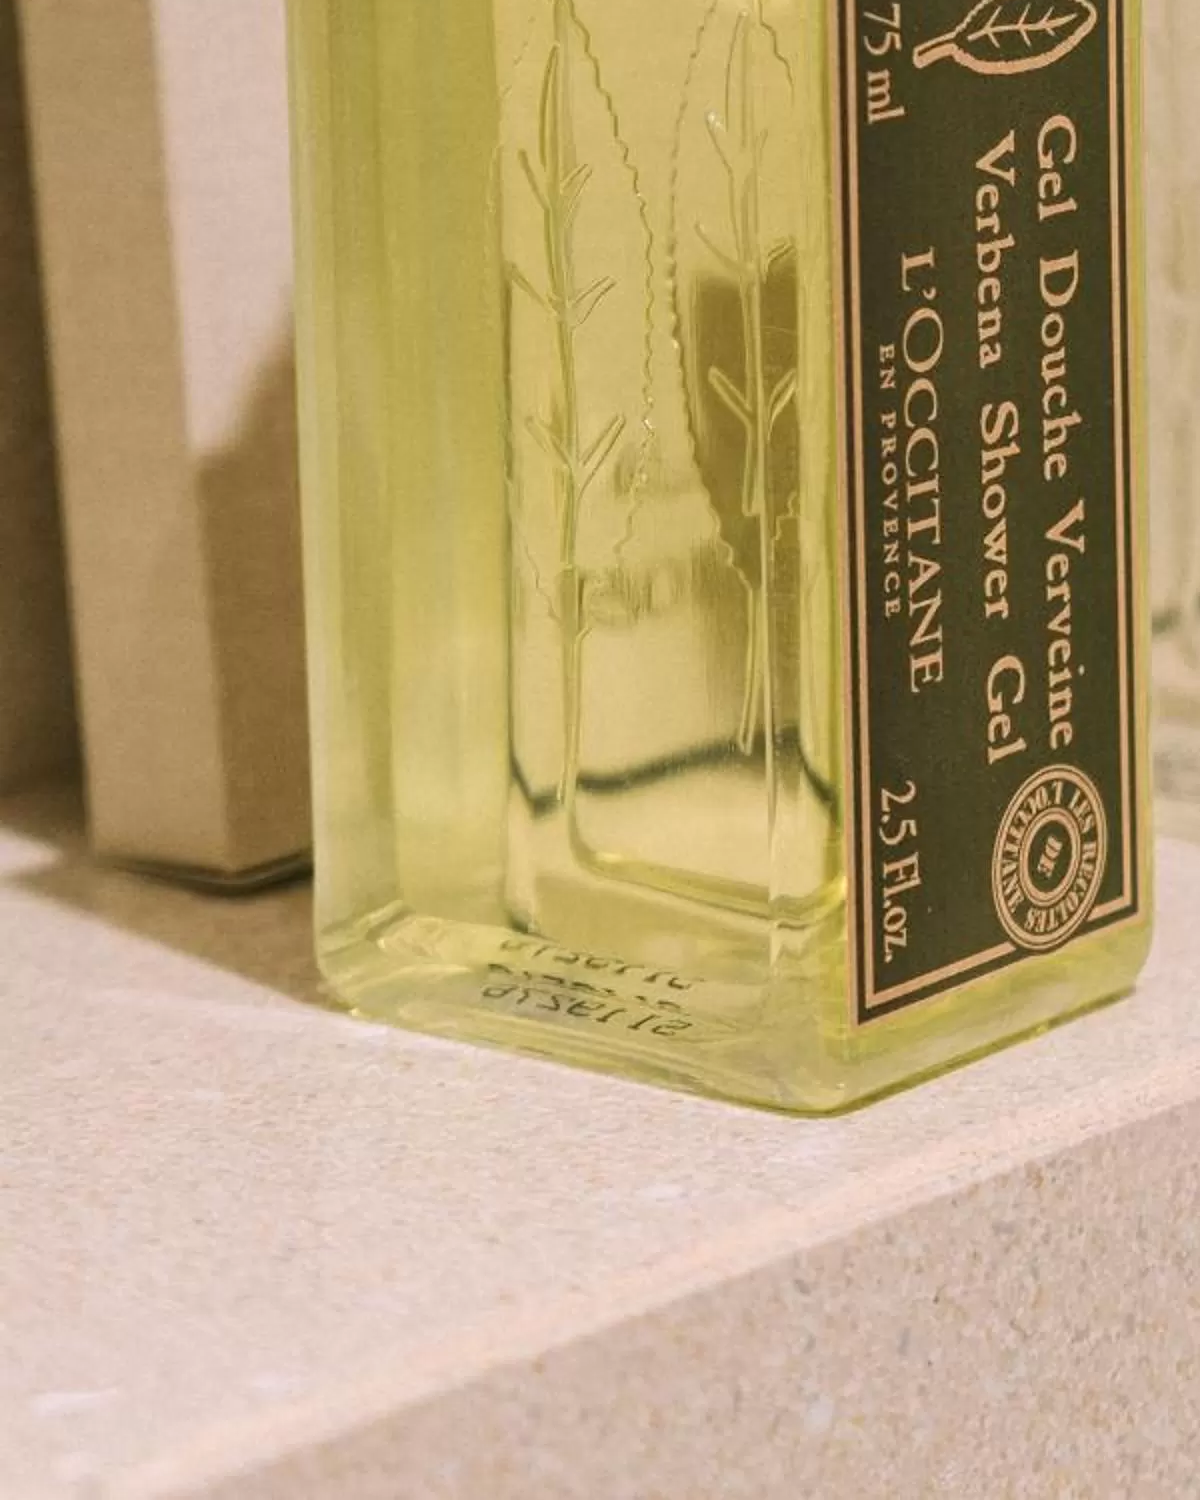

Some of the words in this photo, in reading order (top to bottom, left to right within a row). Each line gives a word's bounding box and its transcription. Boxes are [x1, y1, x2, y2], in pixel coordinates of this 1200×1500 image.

[864, 3, 902, 56] 75
[866, 68, 906, 124] ml
[1037, 114, 1079, 221] Gel
[975, 129, 1017, 369] Verbena
[879, 343, 896, 390] EN
[1038, 248, 1083, 482] Douche
[879, 409, 901, 619] PROVENCE
[901, 246, 945, 694] L'OCCITANE
[979, 400, 1022, 620] Shower
[1044, 499, 1086, 750] Verveine
[986, 653, 1028, 765] Gel
[878, 779, 918, 846] 2.5
[1067, 788, 1097, 834] LES
